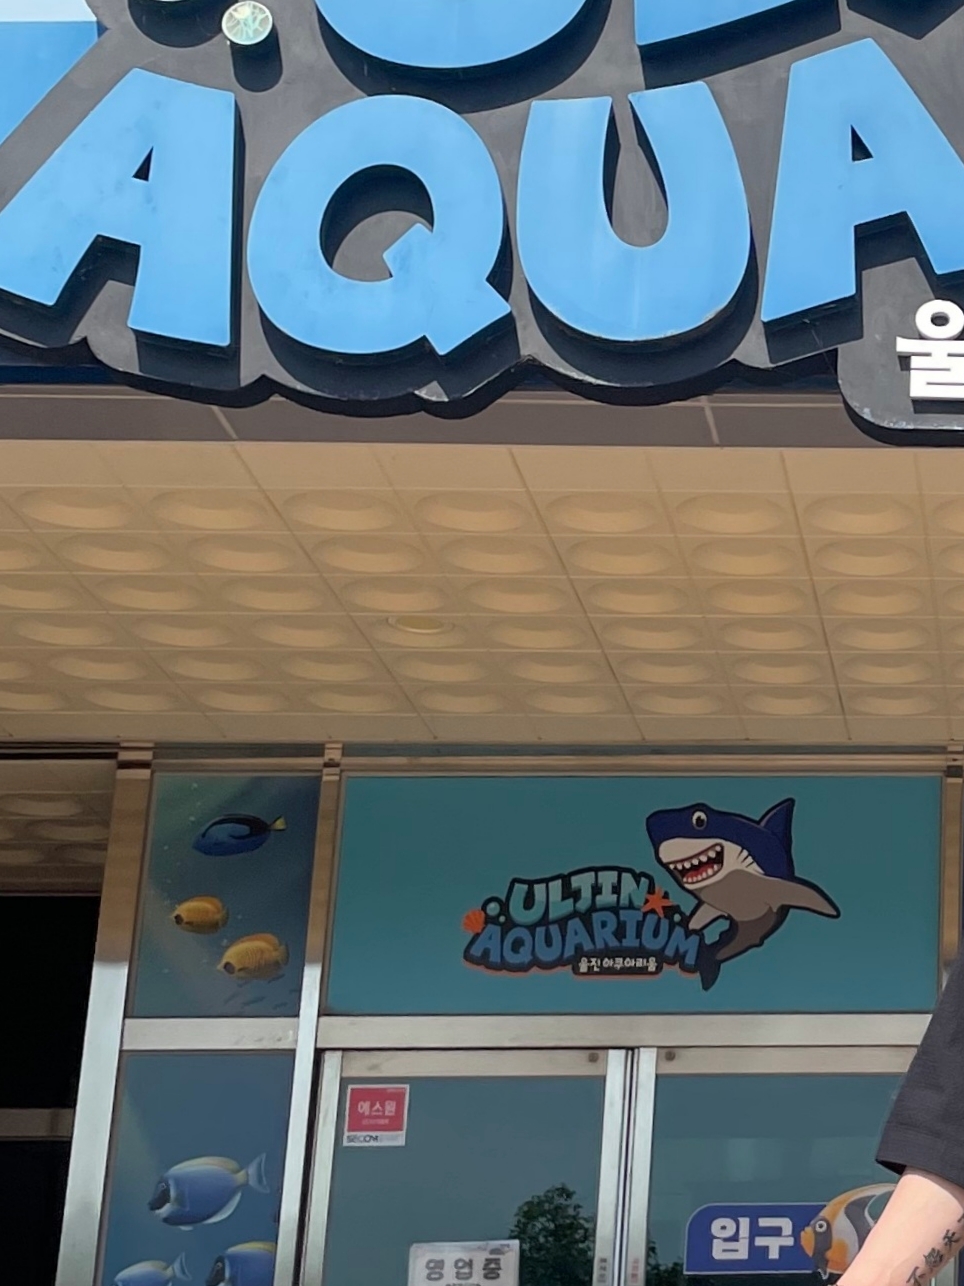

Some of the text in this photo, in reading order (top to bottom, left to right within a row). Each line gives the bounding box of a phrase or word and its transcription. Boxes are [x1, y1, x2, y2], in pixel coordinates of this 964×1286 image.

[508, 870, 650, 926] ULJIN
[469, 909, 700, 967] AQUARIUM
[357, 1100, 396, 1117] 에스원
[710, 1217, 795, 1261] 입구
[425, 1257, 502, 1282] 영업중
